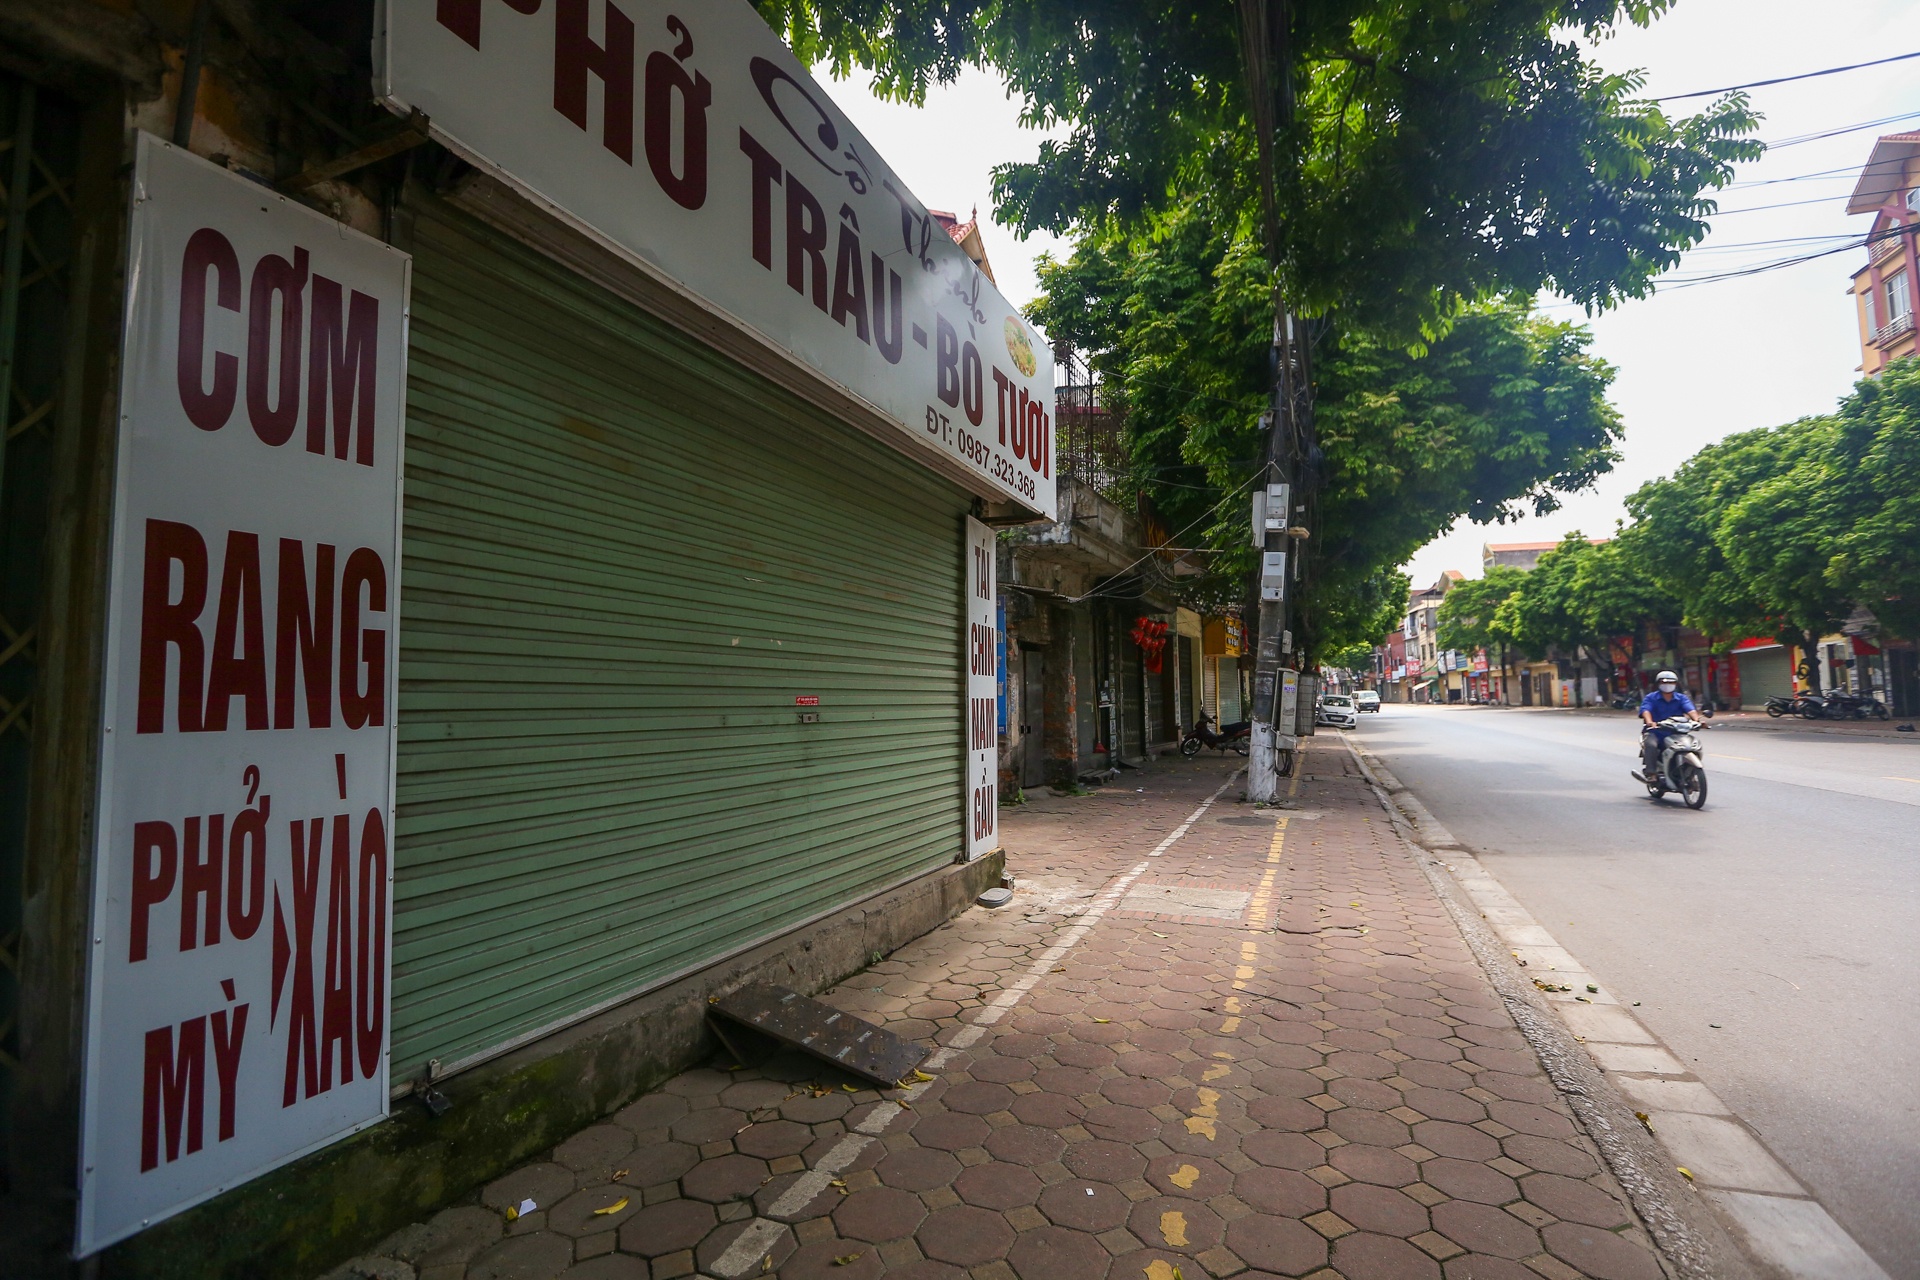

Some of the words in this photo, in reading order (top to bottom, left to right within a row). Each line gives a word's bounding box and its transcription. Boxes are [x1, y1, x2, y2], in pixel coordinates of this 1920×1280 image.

[436, 0, 711, 210] HỞ
[739, 126, 903, 365] TRÂU
[937, 312, 984, 427] BÒ
[993, 365, 1049, 480] TƯƠI
[178, 227, 379, 467] CƠM
[926, 405, 953, 446] ĐT:
[958, 428, 1035, 500] 0987.323.368
[137, 518, 387, 734] RANG
[971, 615, 994, 676] CHÍN
[975, 539, 990, 600] TÁI
[129, 764, 271, 963] PHỞ
[283, 753, 387, 1109] XÀO
[140, 978, 250, 1174] MỲ
